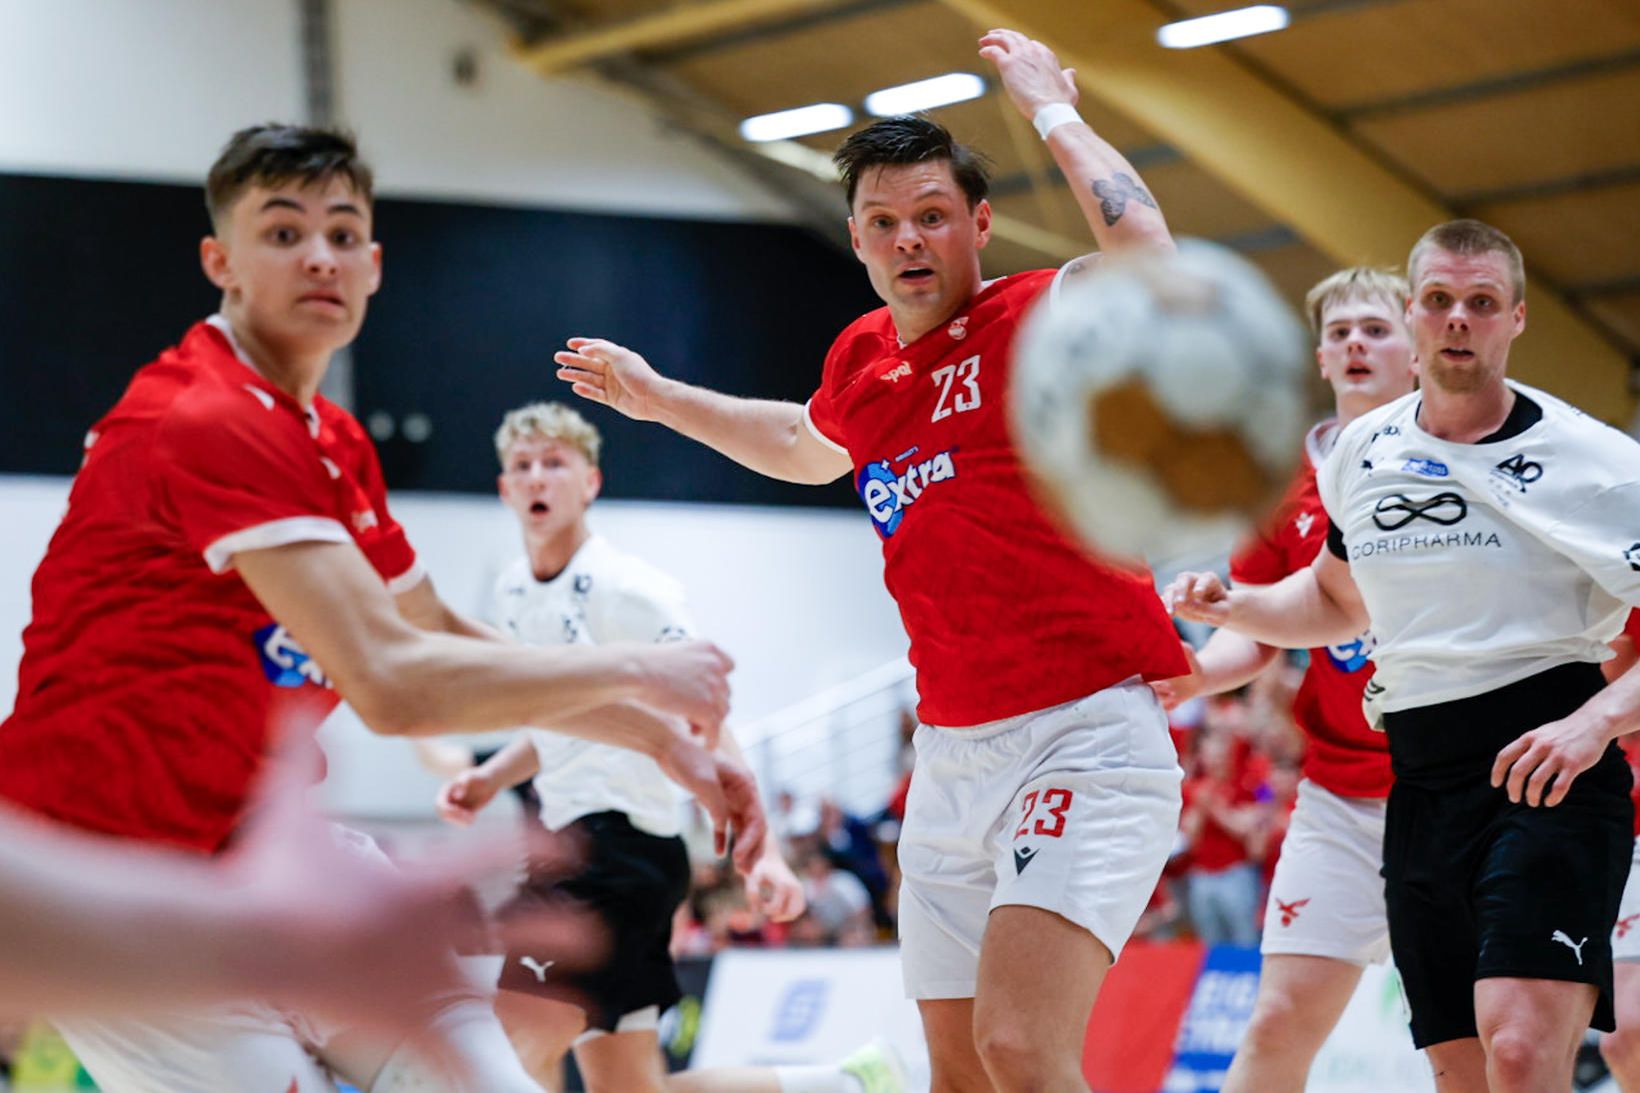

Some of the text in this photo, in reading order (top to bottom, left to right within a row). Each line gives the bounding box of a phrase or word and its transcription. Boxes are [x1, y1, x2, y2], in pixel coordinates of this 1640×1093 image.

[931, 354, 981, 423] 23
[864, 452, 955, 523] extra
[1352, 532, 1502, 560] CORIPHARMA
[1013, 788, 1073, 840] 23
